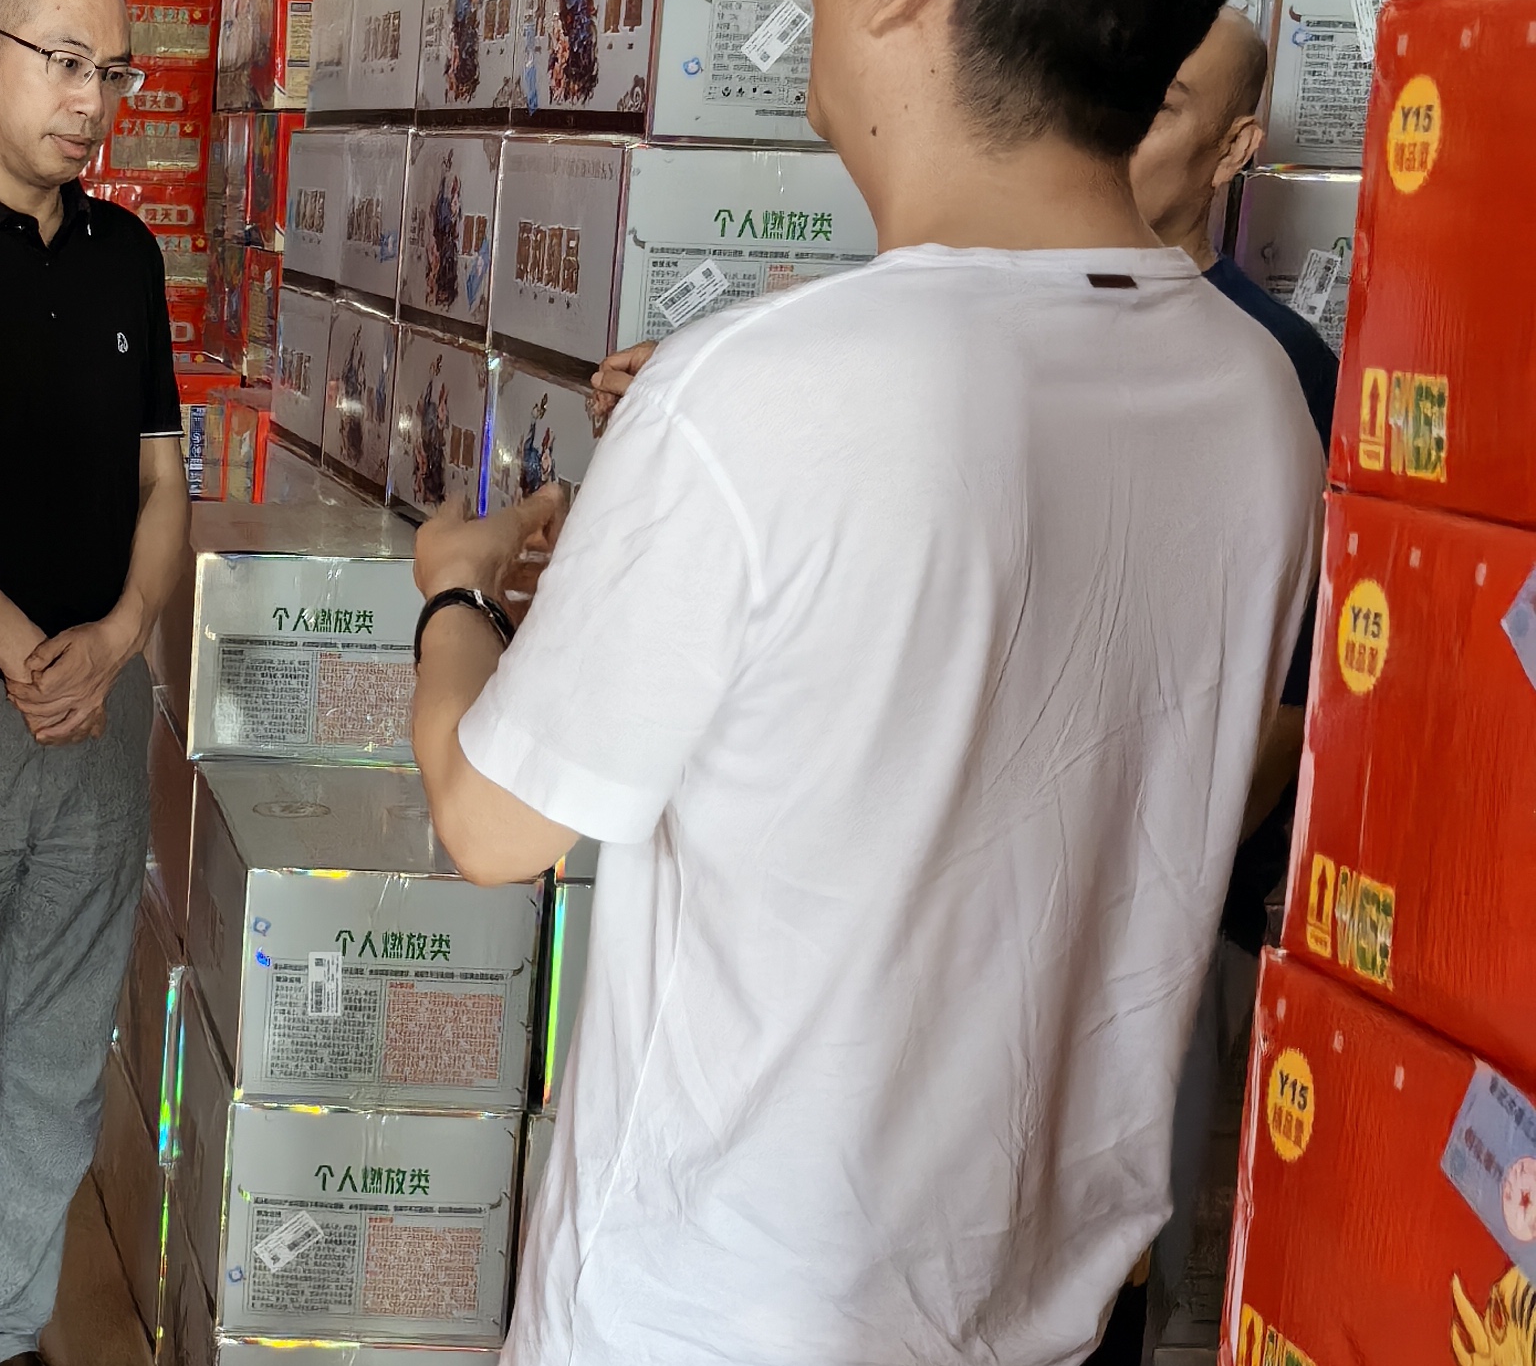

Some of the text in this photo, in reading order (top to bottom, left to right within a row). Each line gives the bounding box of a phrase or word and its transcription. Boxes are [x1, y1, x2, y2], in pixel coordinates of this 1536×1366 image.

[1400, 104, 1435, 133] Y15
[713, 208, 834, 242] 个人燃放类
[271, 606, 375, 635] 个人燃放类
[1350, 604, 1383, 639] Y15
[335, 929, 451, 962] 个人燃放类
[1278, 1069, 1309, 1112] Y15
[314, 1164, 432, 1198] 个人燃放类
